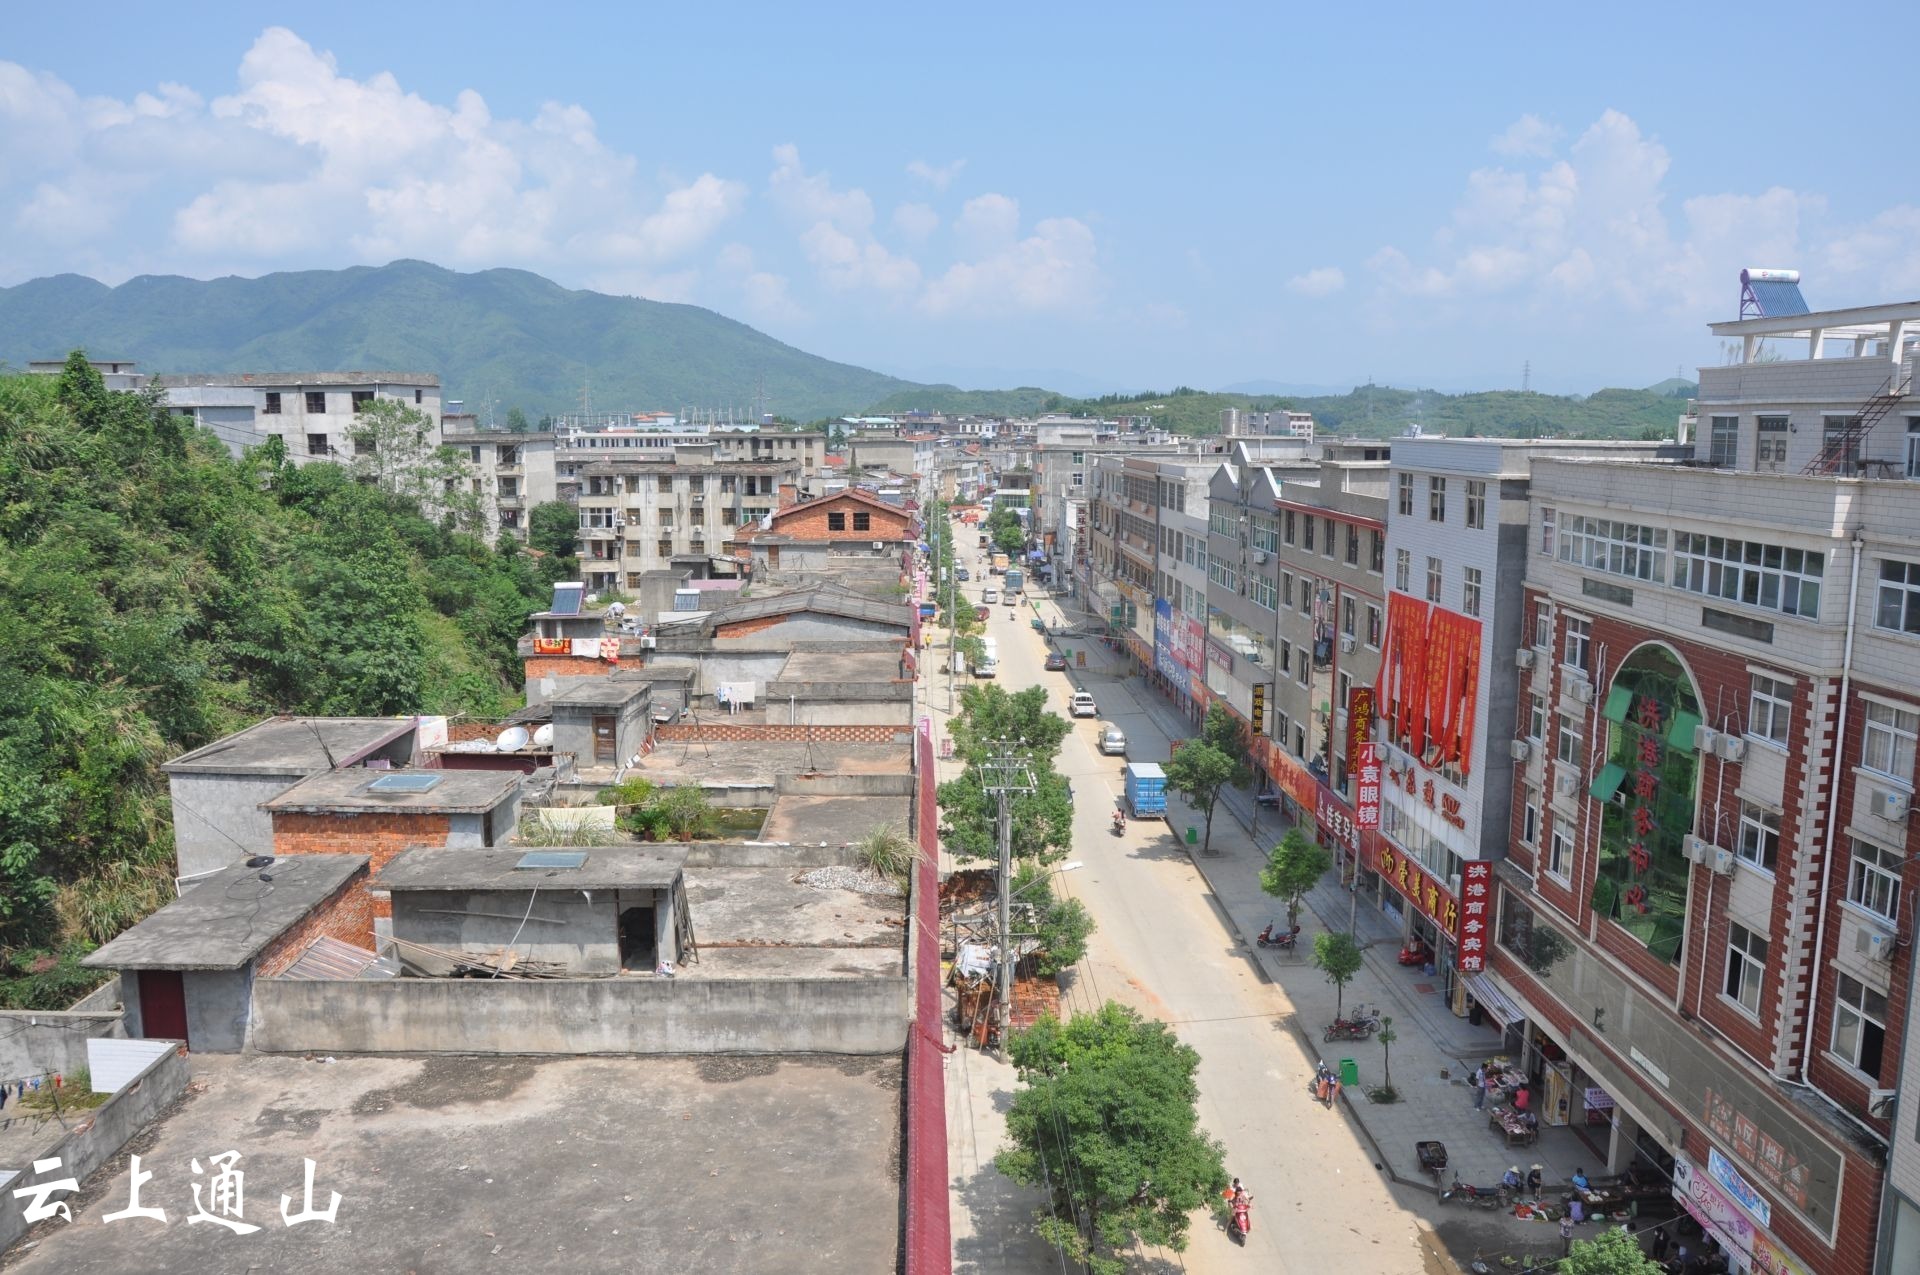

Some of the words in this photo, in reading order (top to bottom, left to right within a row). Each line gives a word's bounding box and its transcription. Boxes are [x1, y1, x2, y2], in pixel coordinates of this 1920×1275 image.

[1358, 745, 1380, 824] 小袁眼镜
[1398, 859, 1457, 933] 爱美商行
[1462, 865, 1488, 969] 洪港商务宾馆
